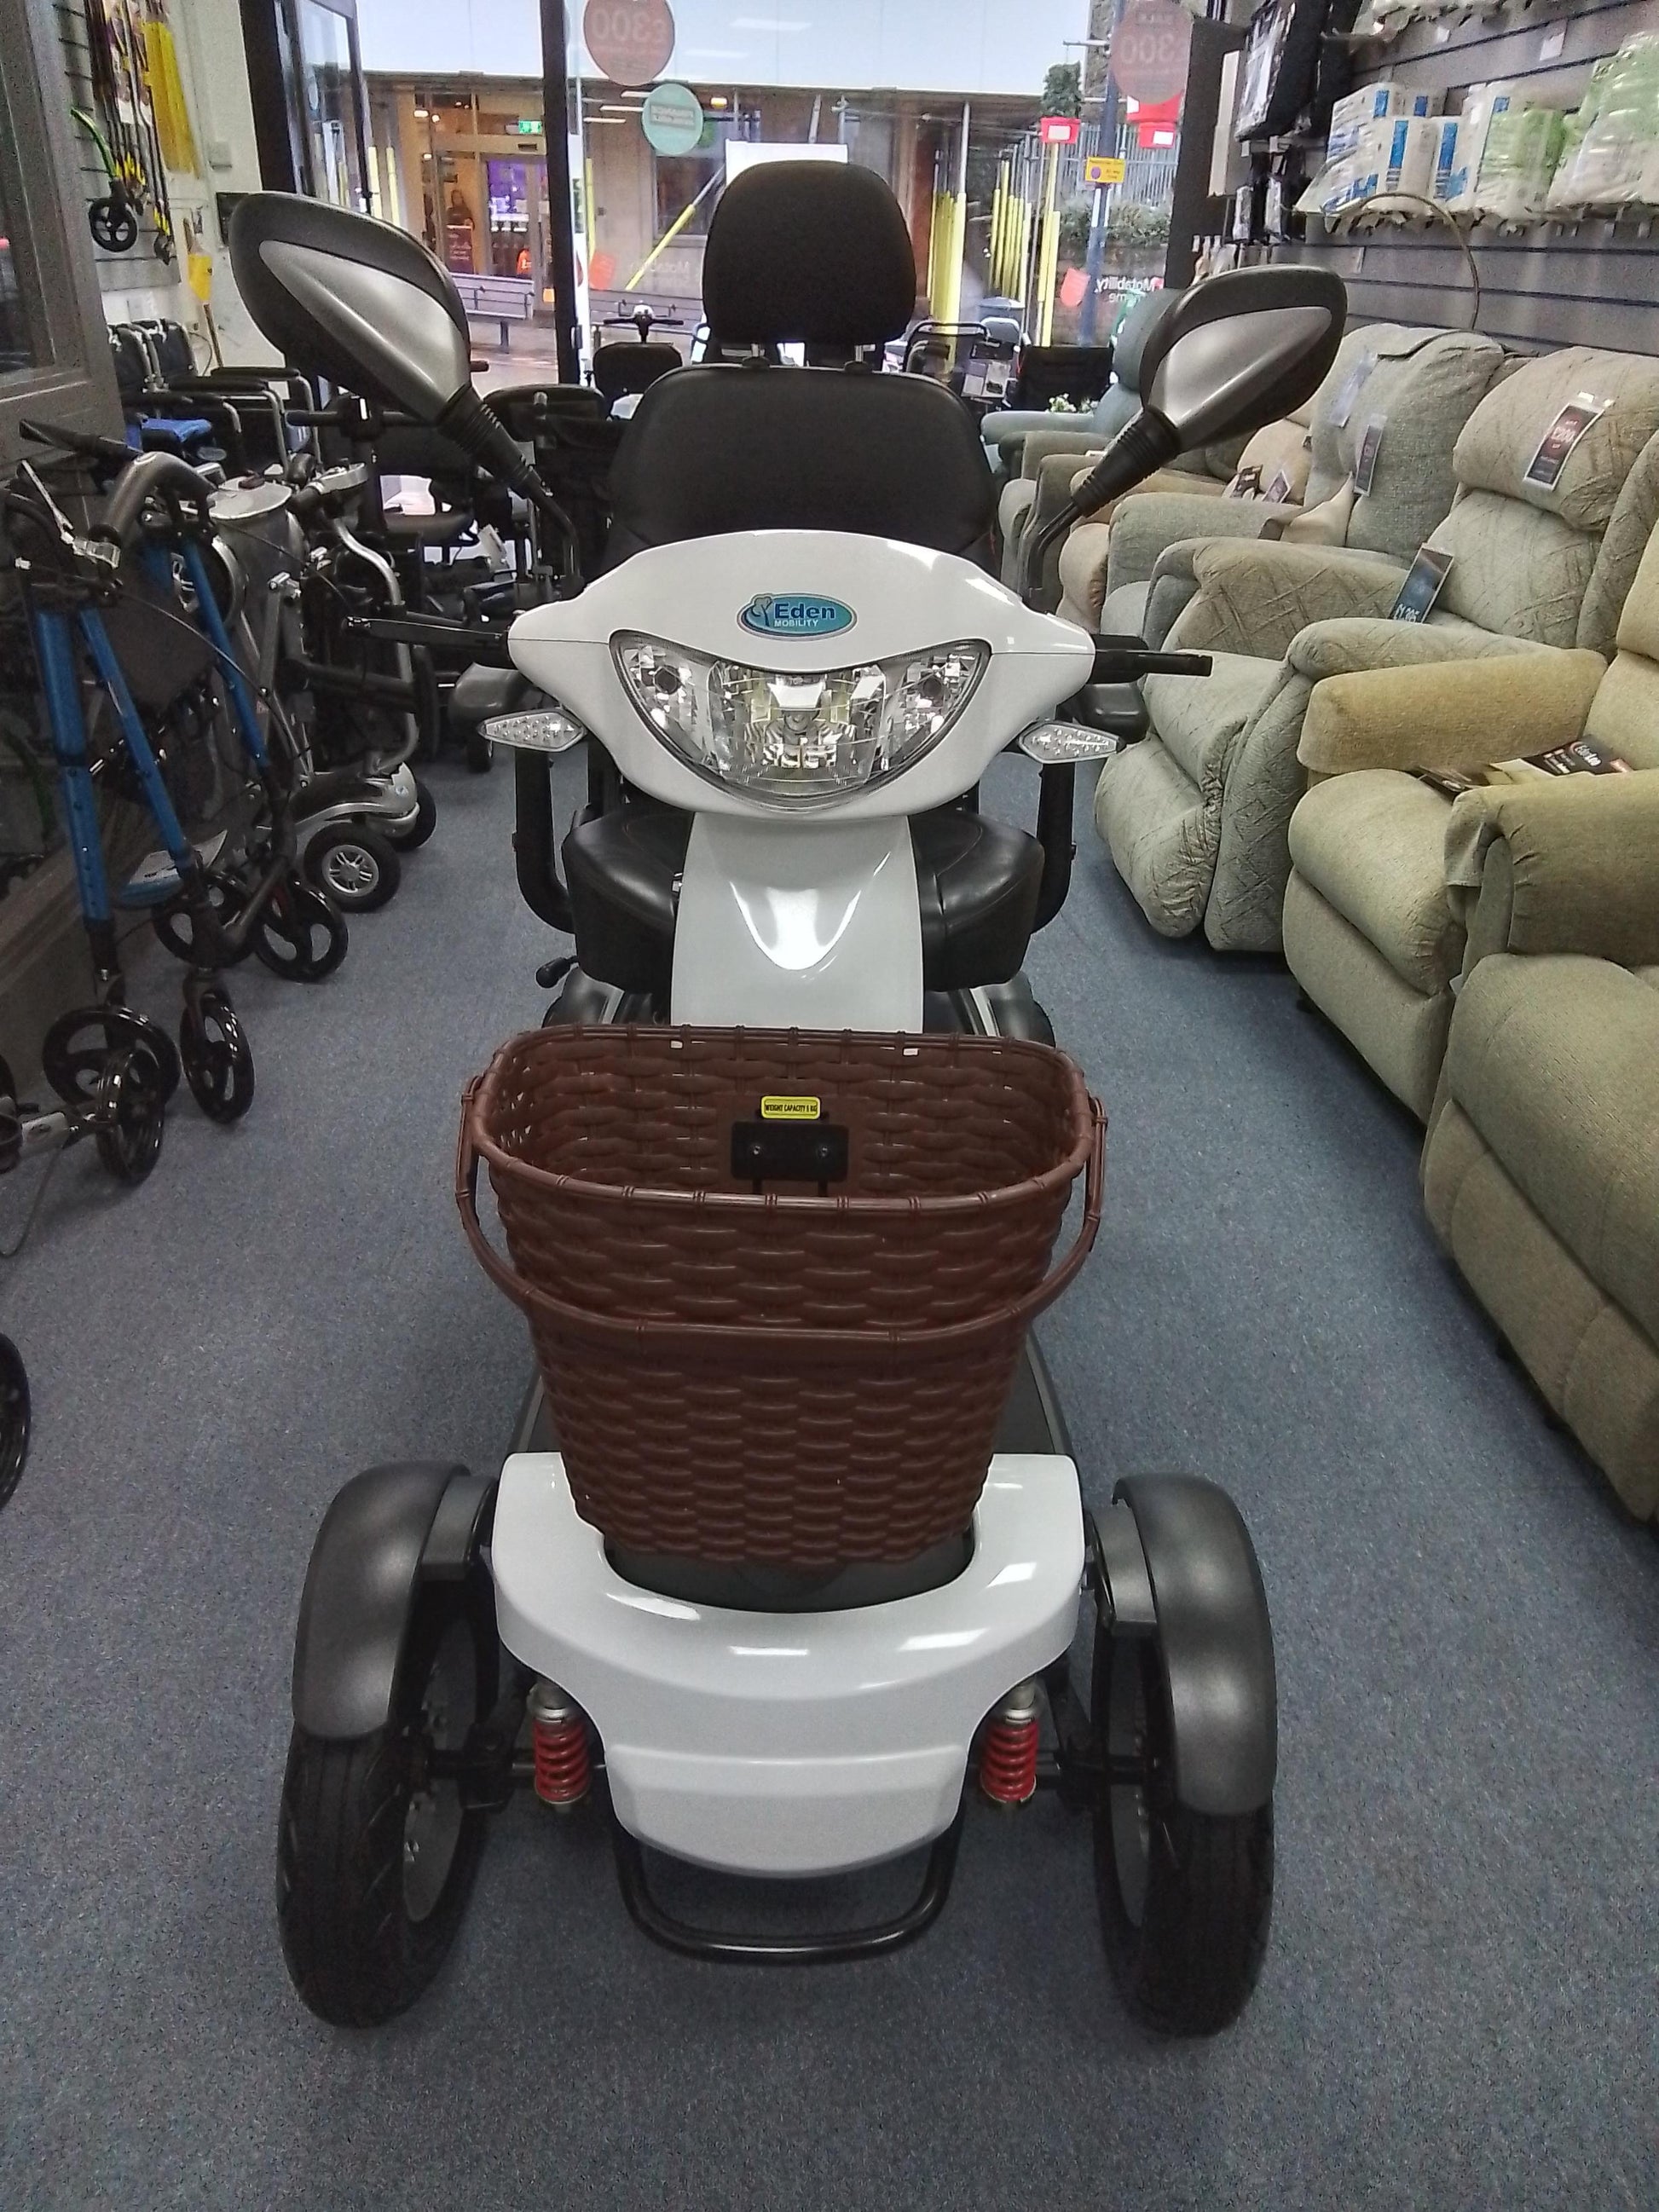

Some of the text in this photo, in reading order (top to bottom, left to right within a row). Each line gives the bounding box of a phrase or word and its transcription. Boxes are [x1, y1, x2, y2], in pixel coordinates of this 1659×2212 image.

[774, 602, 835, 620] Eden
[774, 619, 819, 627] MOBILITY
[784, 1104, 806, 1112] CAPACITY
